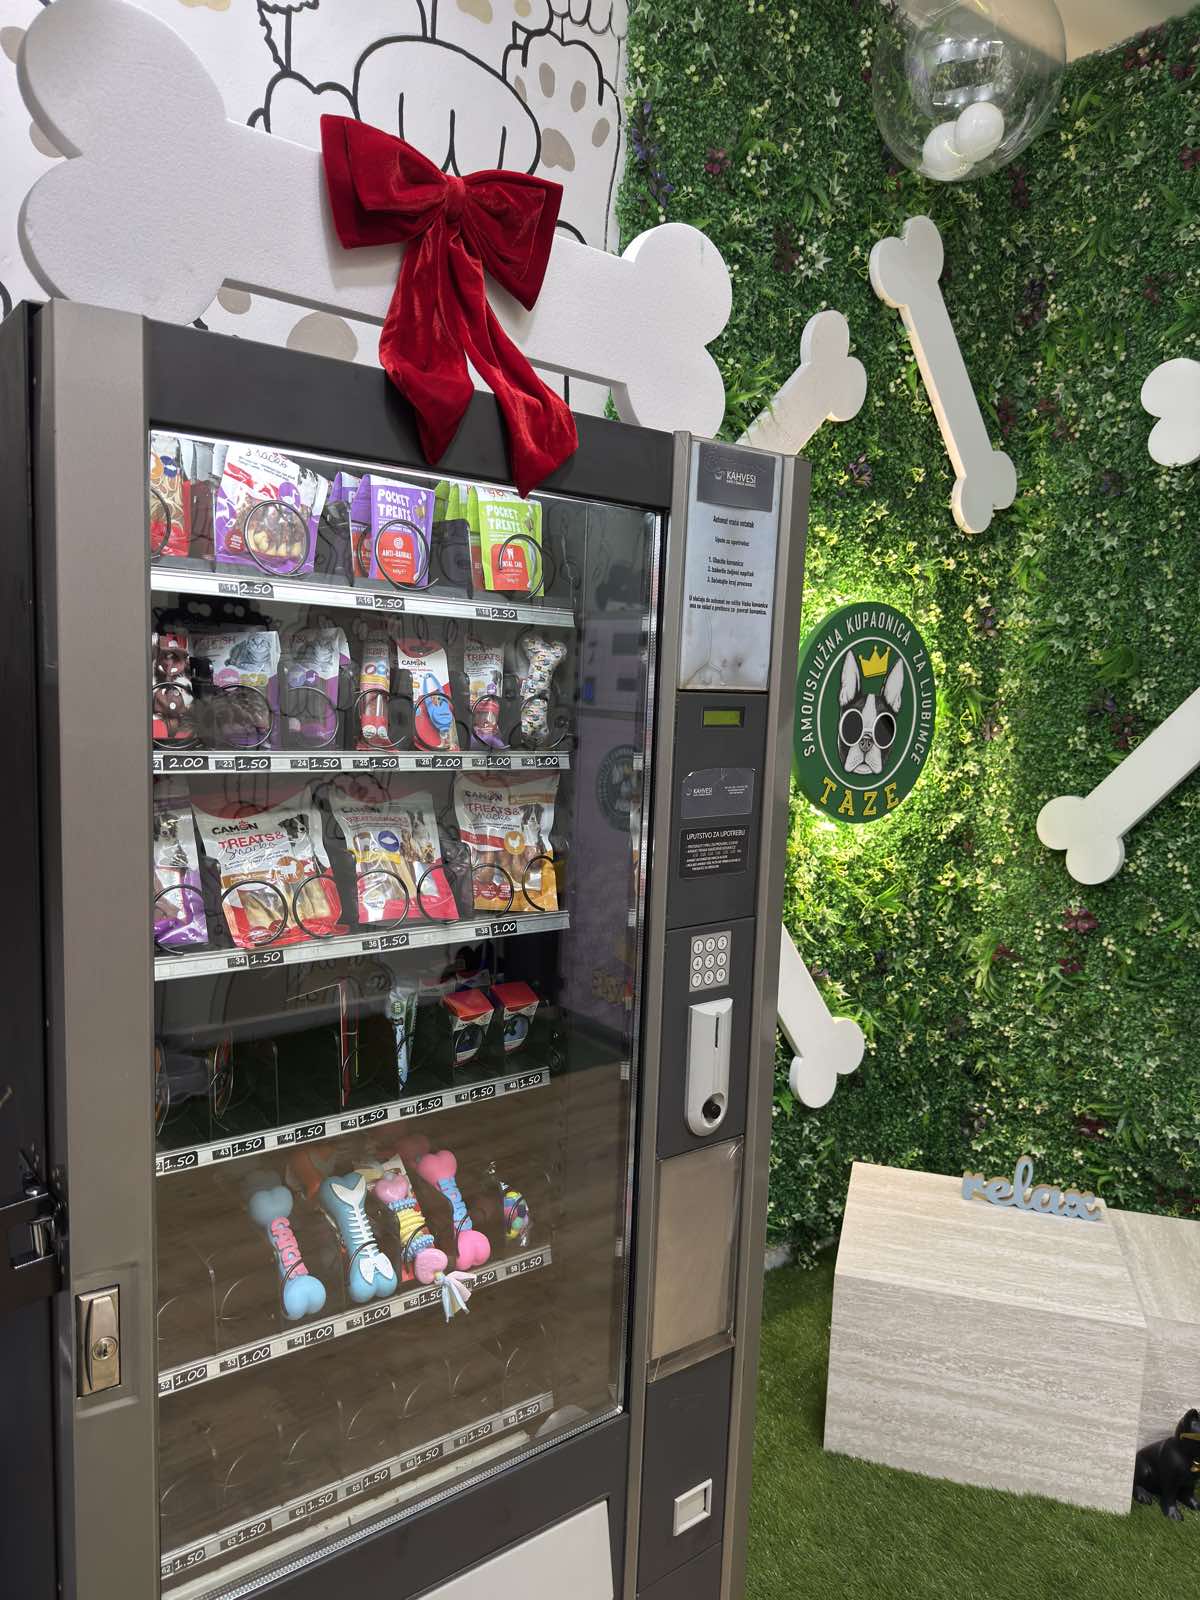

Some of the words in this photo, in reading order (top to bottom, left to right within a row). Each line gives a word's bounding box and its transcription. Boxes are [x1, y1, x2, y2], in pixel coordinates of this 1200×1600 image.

[377, 489, 409, 507] POCKET
[378, 504, 411, 521] TREATS
[486, 505, 518, 520] POCKET
[240, 583, 272, 594] 2.50
[375, 598, 403, 608] 2.50
[492, 609, 515, 618] 2.50
[847, 611, 912, 647] KUPAONICA
[912, 649, 925, 673] ZA
[800, 628, 842, 757] SAMOUSLUŽNA
[911, 677, 932, 766] LJUBIMCE
[169, 758, 203, 768] 2.00
[238, 759, 268, 769] 1.50
[311, 759, 339, 768] 1.50
[371, 758, 397, 768] 1.50
[435, 759, 460, 768] 2.00
[488, 757, 510, 767] 1.00
[537, 757, 558, 766] 1.00
[819, 776, 899, 816] TAZE
[212, 821, 259, 835] CAMON
[687, 832, 712, 840] UPUTSTVO
[494, 923, 516, 933] 1.00
[381, 935, 407, 947] 1.50
[251, 951, 280, 963] 1.50
[520, 1075, 541, 1087] 1.50
[471, 1087, 494, 1099] 1.50
[418, 1098, 441, 1111] 1.50
[359, 1109, 384, 1123] 1.50
[296, 1125, 323, 1139] 1.50
[233, 1138, 262, 1154] 1.50
[165, 1155, 195, 1170] 1.50
[961, 1155, 1104, 1221] relax
[521, 1256, 542, 1271] 1.50
[473, 1271, 494, 1287] 1.50
[420, 1289, 443, 1303] 1.50
[364, 1306, 389, 1323] 1.00
[305, 1326, 333, 1343] 1.00
[240, 1347, 270, 1365] 1.00
[160, 1381, 170, 1389] 52
[175, 1367, 206, 1386] 1.00
[518, 1404, 539, 1420] 1.50
[469, 1425, 490, 1440] 1.50
[417, 1448, 439, 1464] 1.50
[364, 1469, 388, 1488] 1.50
[307, 1492, 333, 1512] 1.50
[238, 1522, 266, 1542] 1.50
[161, 1565, 171, 1573] 62
[175, 1550, 205, 1570] 1.50
